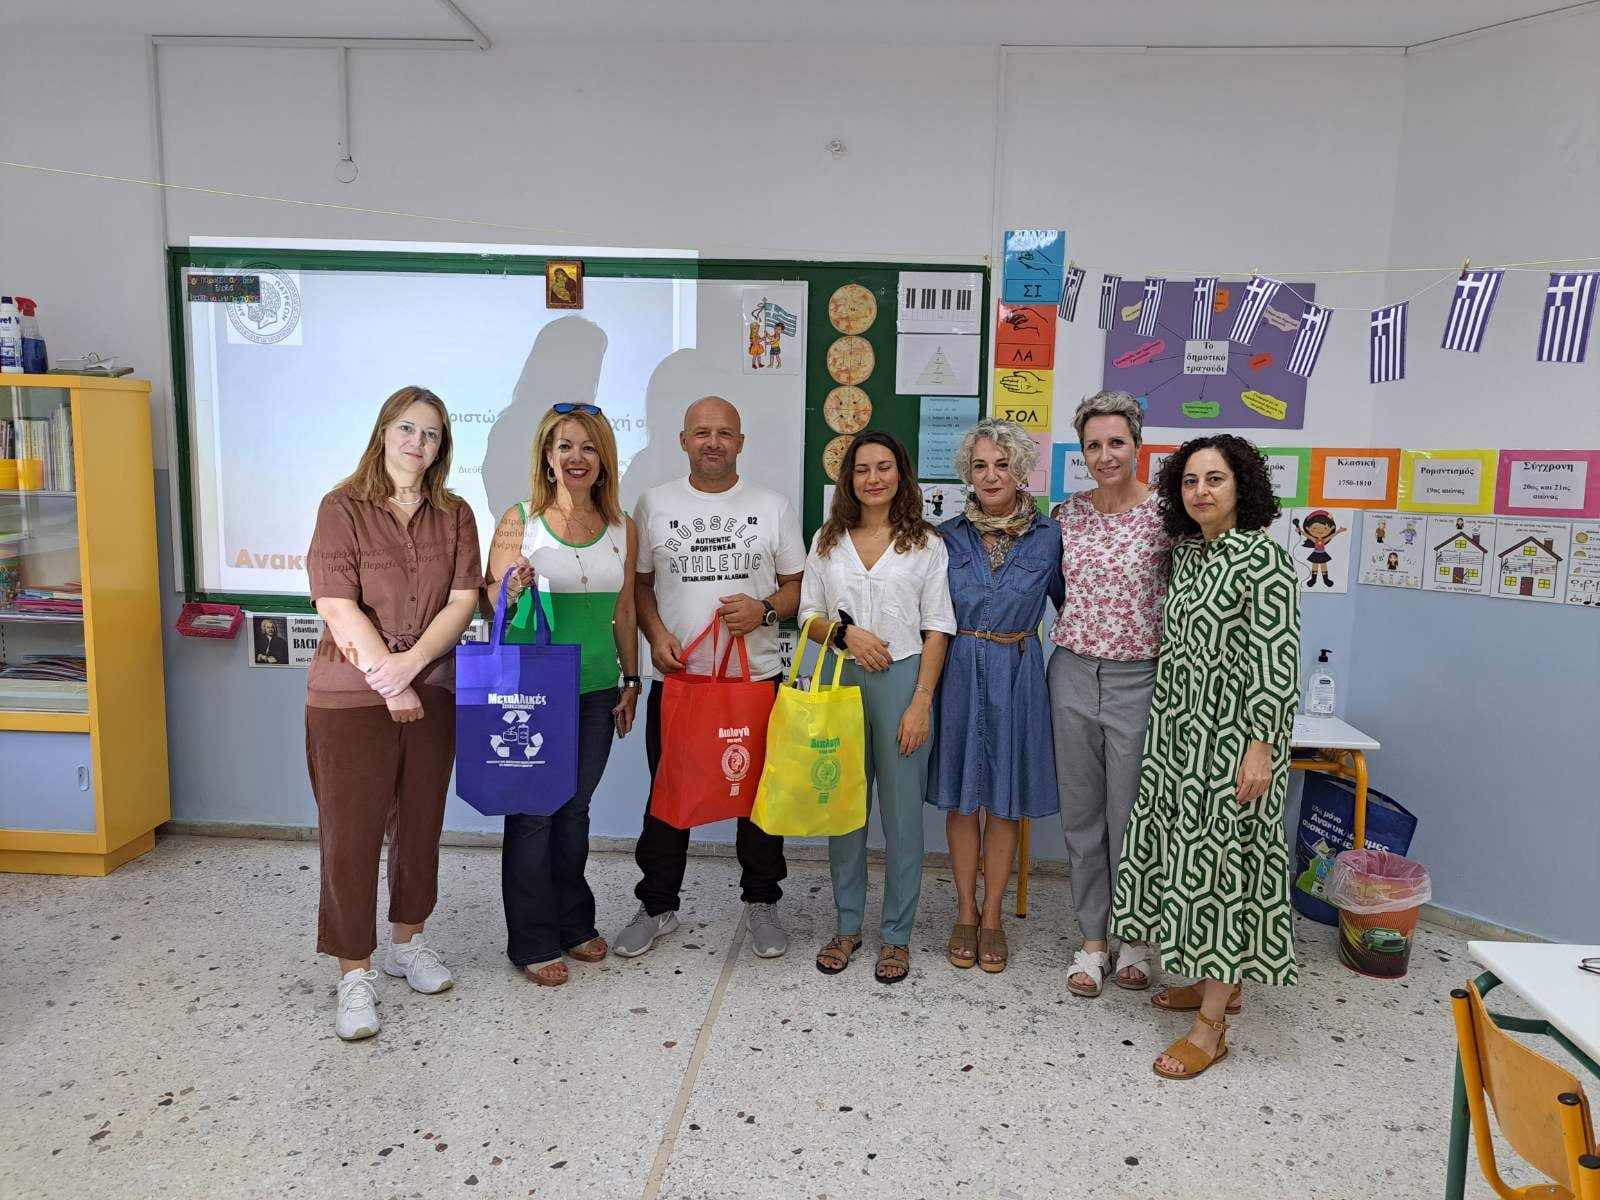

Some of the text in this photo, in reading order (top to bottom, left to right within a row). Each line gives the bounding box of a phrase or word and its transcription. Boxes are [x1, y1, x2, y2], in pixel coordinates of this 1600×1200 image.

[1023, 284, 1042, 298] ΣΙ
[1203, 341, 1214, 350] Το
[1012, 348, 1033, 362] ΛΑ
[1186, 353, 1226, 362] δημοτικό
[1186, 364, 1225, 374] τραγούδι
[1004, 409, 1039, 423] ΣΟΛ
[1337, 457, 1376, 469] Κλασική
[1523, 461, 1575, 473] Σύγχρονη
[1420, 465, 1475, 476] Ρομαντισμός
[1338, 479, 1373, 487] 1750-1810
[664, 515, 758, 552] RUSSELL
[695, 536, 732, 545] AUTHENTIC
[690, 543, 737, 553] SPORTSWEAR
[669, 552, 762, 574] ATHLETIC
[681, 575, 716, 583] ESTABLISHED
[724, 573, 749, 581] ALABAMA
[291, 626, 319, 634] Sebastian
[293, 638, 318, 649] BACH
[488, 692, 547, 705] Μεταλλικές
[718, 726, 750, 738] Διαλογή
